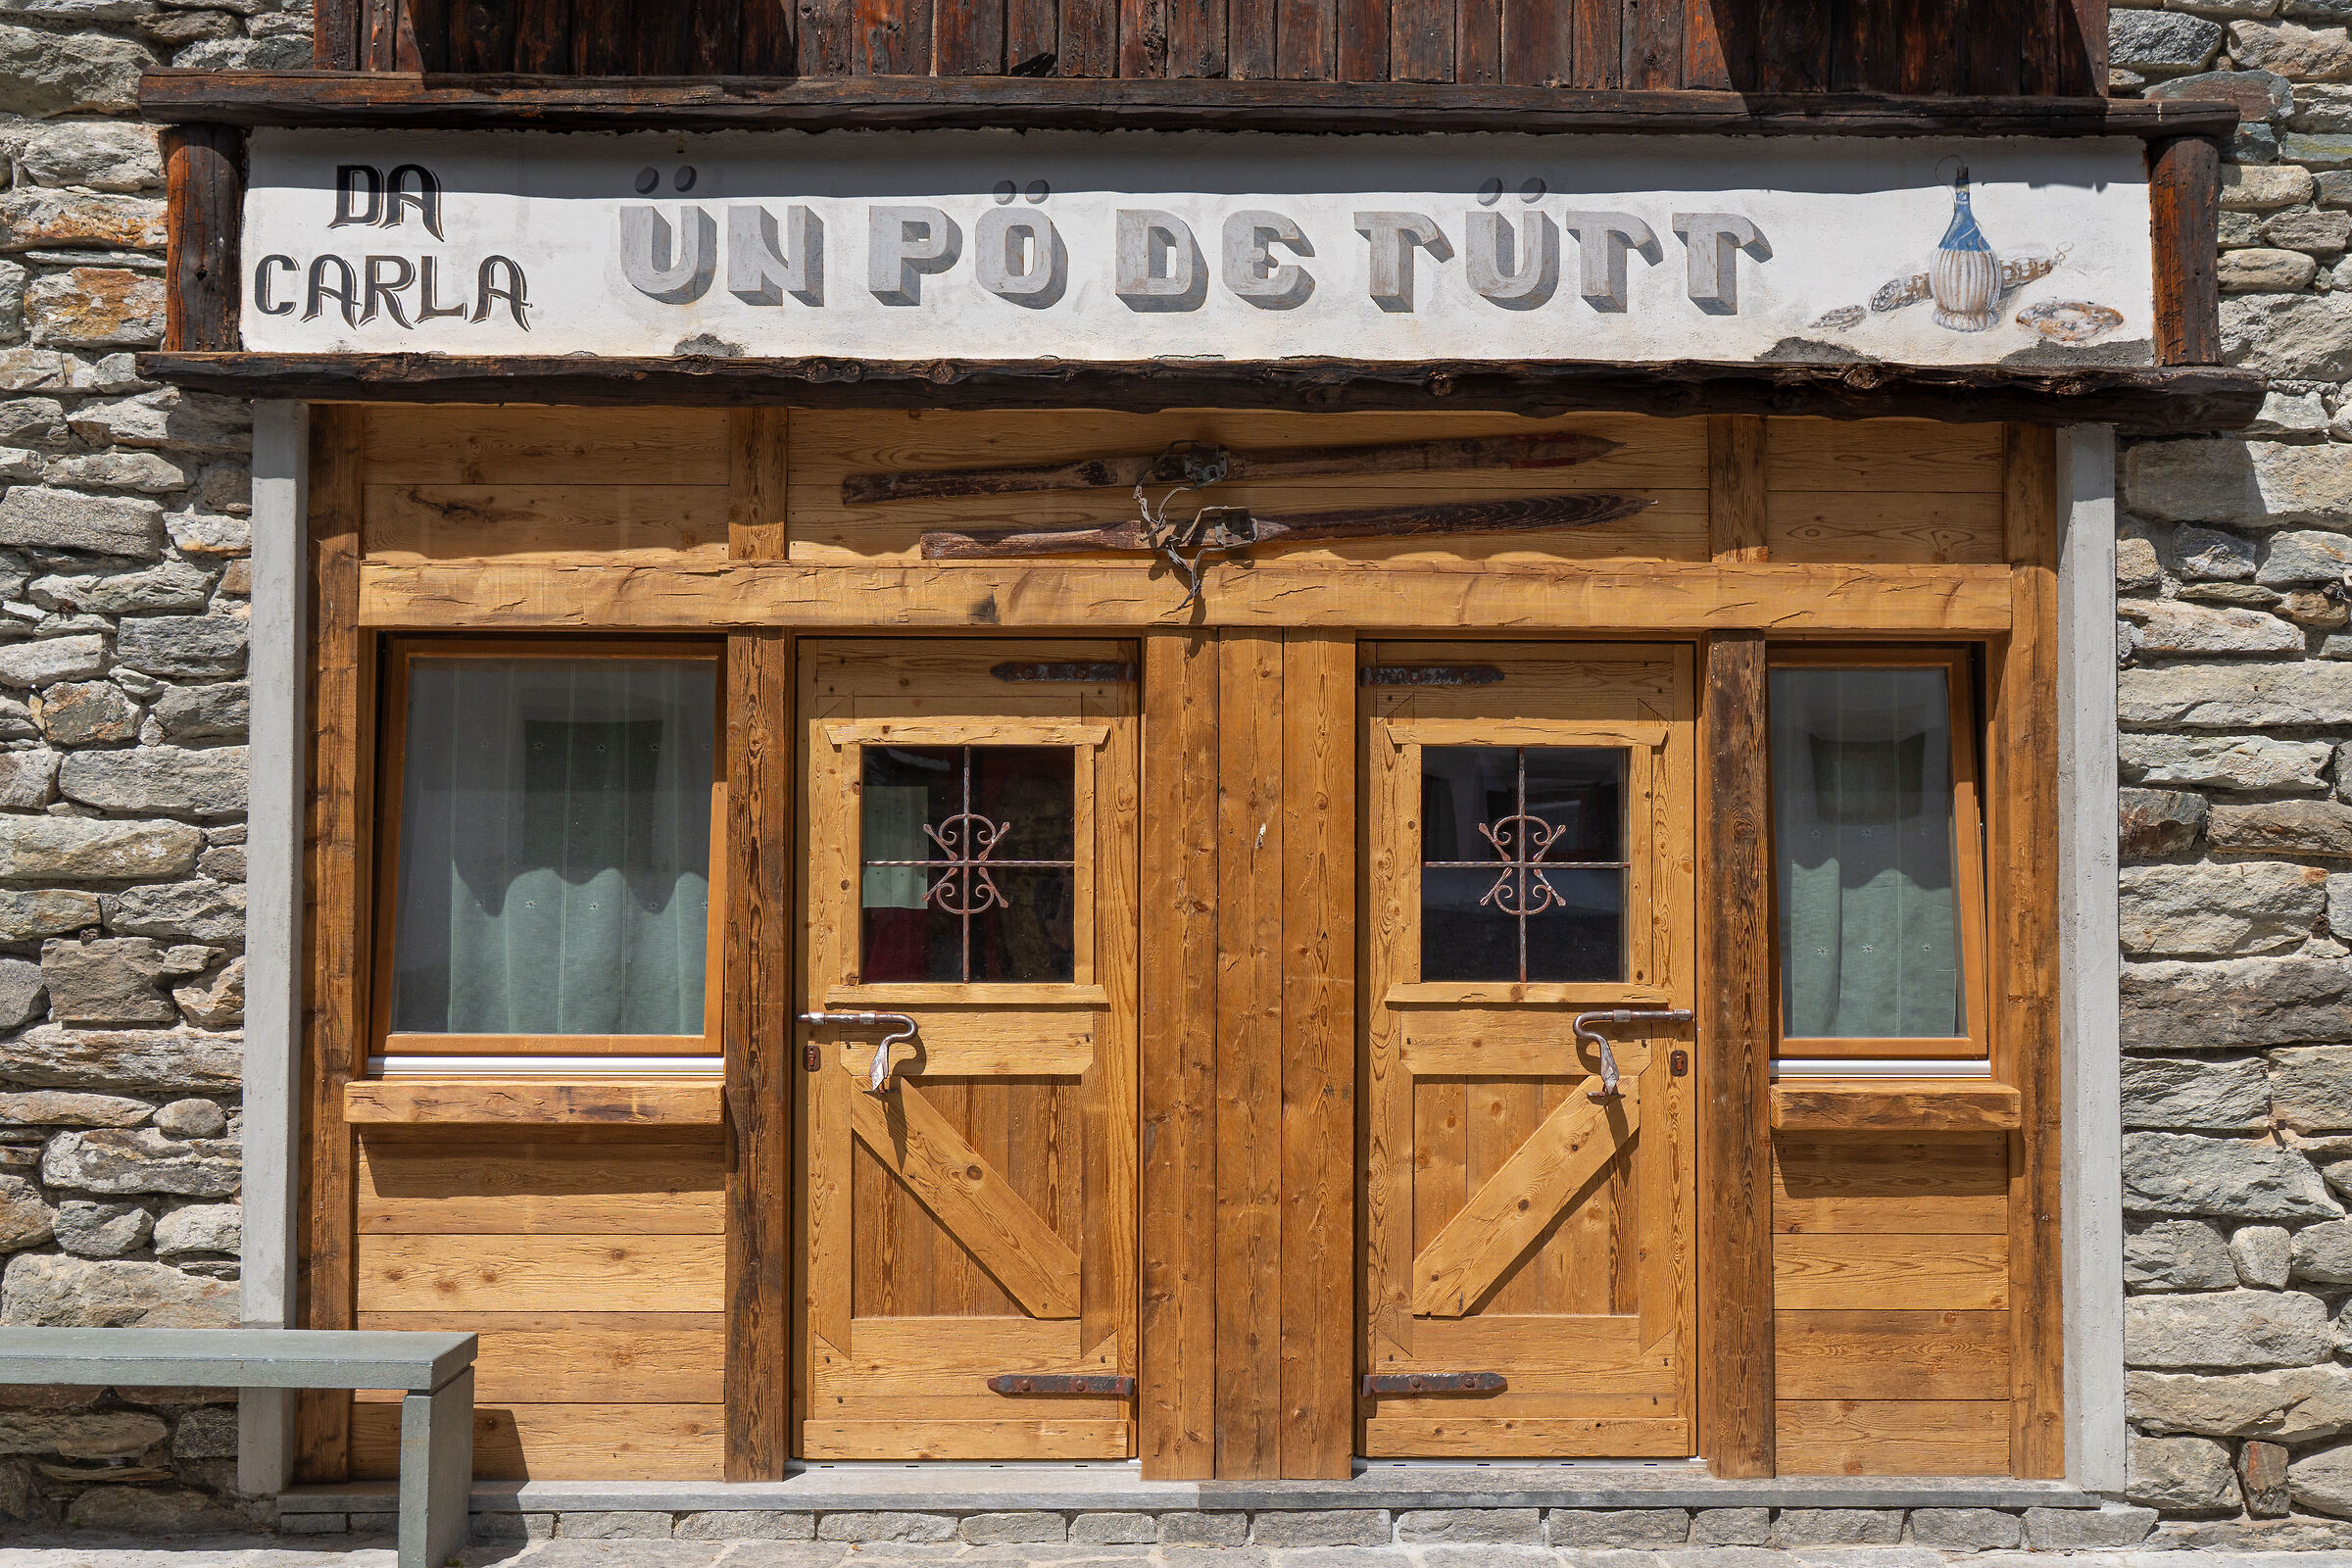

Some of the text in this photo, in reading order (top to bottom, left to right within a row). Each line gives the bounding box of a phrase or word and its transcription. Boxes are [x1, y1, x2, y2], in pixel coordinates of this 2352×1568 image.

[328, 164, 444, 242] DA
[619, 165, 1775, 316] ÜN PÖ DE TÜTT
[254, 254, 533, 332] CARLA
